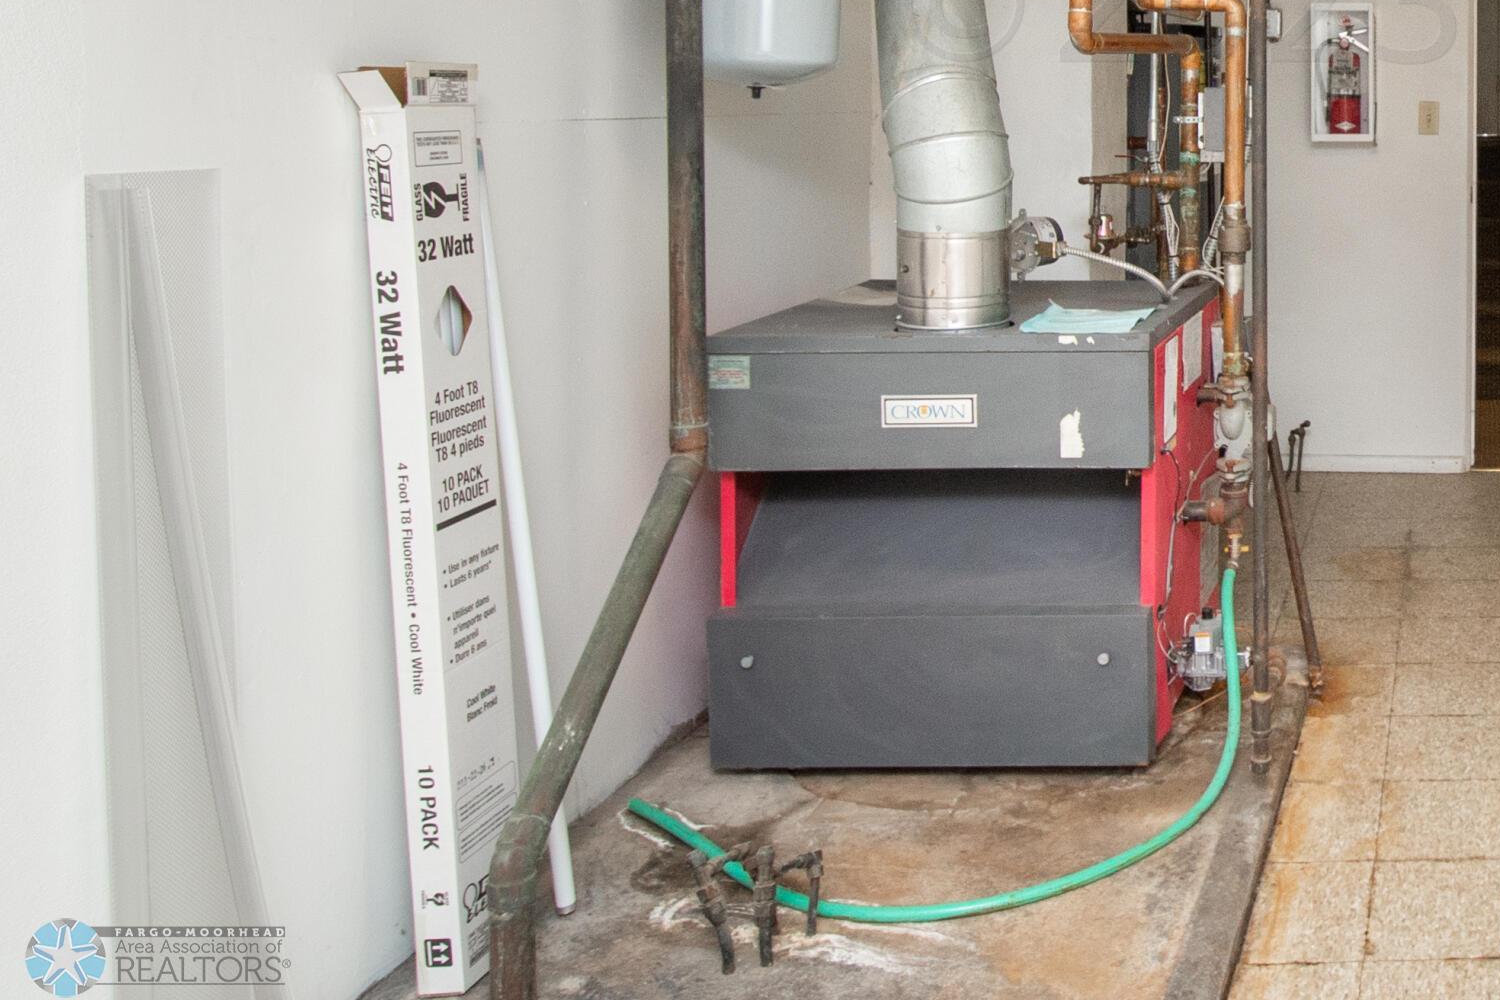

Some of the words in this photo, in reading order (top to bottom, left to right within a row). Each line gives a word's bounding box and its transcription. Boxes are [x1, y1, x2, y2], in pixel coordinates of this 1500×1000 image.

[414, 183, 424, 221] GLASS
[459, 173, 470, 222] FRAGILE
[417, 238, 437, 262] 32
[440, 232, 475, 258] Watt
[376, 270, 398, 304] 32
[379, 311, 405, 375] Watt
[434, 392, 440, 405] 4
[444, 387, 465, 404] Foot
[467, 380, 479, 396] T8
[429, 395, 486, 426] Fluorescent
[891, 404, 967, 419] CROWN
[431, 416, 487, 447] Fluorescent
[436, 447, 448, 463] T8
[450, 443, 457, 457] 4
[459, 434, 485, 457] pieds
[397, 462, 408, 471] 4
[442, 476, 455, 493] 10
[457, 464, 484, 488] PACK
[398, 475, 409, 504] Foot
[437, 498, 450, 513] 10
[453, 479, 490, 508] PAQUET
[400, 508, 413, 524] T8
[401, 528, 418, 608] Fluorescent
[408, 623, 421, 653] Cool
[411, 657, 424, 696] White
[417, 766, 435, 790] 10
[420, 796, 440, 850] PACK
